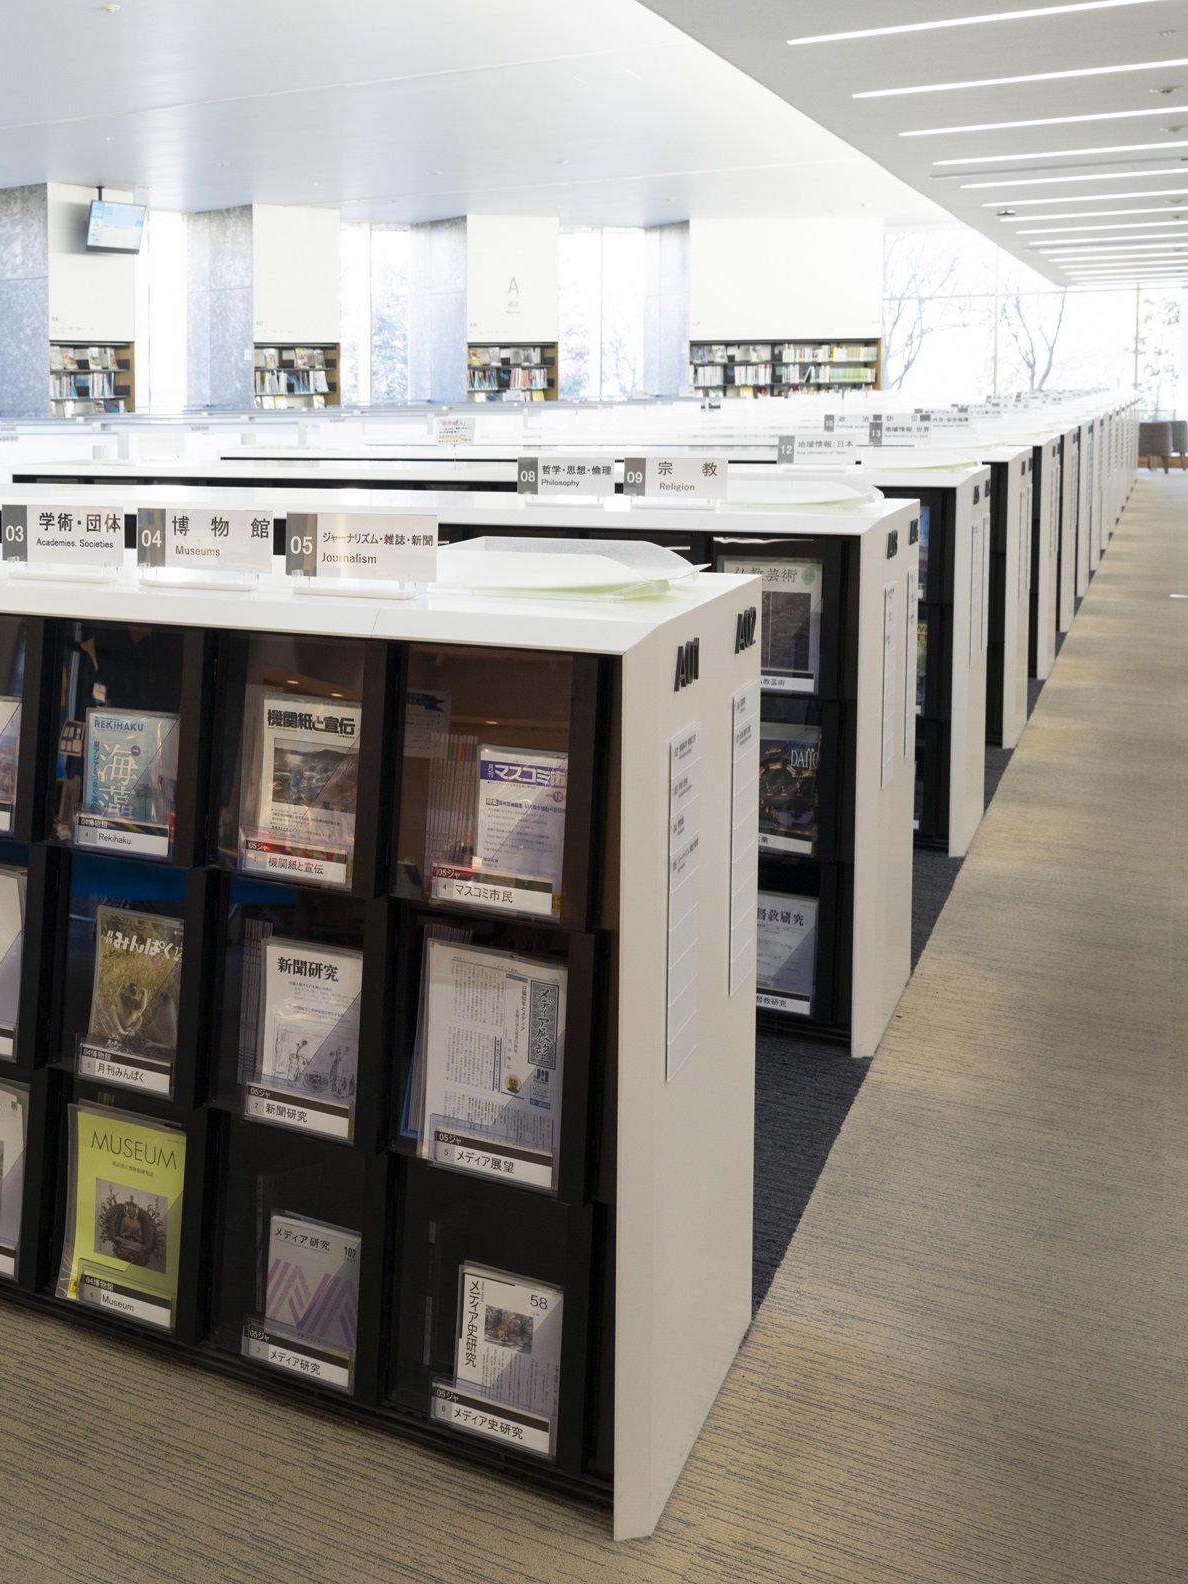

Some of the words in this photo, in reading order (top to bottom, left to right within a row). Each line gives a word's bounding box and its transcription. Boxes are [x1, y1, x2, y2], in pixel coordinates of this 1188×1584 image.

[508, 277, 519, 294] A
[780, 446, 792, 454] 12
[520, 471, 536, 482] 08
[542, 465, 611, 475] 哲学・思想・倫理
[658, 461, 672, 475] 宗
[702, 462, 717, 477] 教
[541, 479, 579, 487] Philosophy
[627, 472, 642, 483] 09
[660, 483, 695, 492] Religion
[39, 512, 121, 533] 学術・団体
[172, 516, 190, 536] 博
[211, 517, 229, 537] 物
[250, 518, 270, 539] 館
[6, 526, 24, 542] 03
[142, 530, 162, 548] 04
[322, 533, 433, 546] ジャーナリズム・雑誌・新聞
[79, 540, 113, 548] Societies
[175, 546, 221, 557] Museums
[290, 536, 313, 554] 05
[322, 553, 377, 564] Journalism
[735, 607, 756, 654] A02
[674, 637, 699, 692] A01
[761, 678, 785, 687] 教芸術
[267, 709, 355, 735] 機関紙と宣伝
[488, 763, 494, 777] 月刊
[81, 819, 107, 828] 04博物館
[98, 833, 131, 844] Rekihaku
[268, 857, 324, 874] 機関紙と宣伝
[438, 868, 460, 878] 05ジャ
[455, 884, 513, 903] マスコミ市民
[757, 907, 804, 926] 督教研究
[114, 931, 174, 959] みんぱく
[277, 956, 339, 982] 新聞研究
[756, 995, 787, 1008] 督教研究
[534, 988, 553, 1064] メディア展望
[84, 1048, 112, 1061] 04博物館
[97, 1063, 144, 1083] 月刊みんぱく
[251, 1088, 270, 1098] 05ジャ
[266, 1103, 307, 1123] 新聞研究
[439, 1133, 462, 1146] 05ジャ
[91, 1131, 177, 1170] MUSEUM
[456, 1150, 515, 1174] メディア展望
[344, 1247, 356, 1258] 107
[86, 1277, 114, 1292] 04博物館
[102, 1294, 134, 1312] Museum
[530, 1294, 548, 1310] 58
[465, 1280, 479, 1368] メディア史研究
[250, 1330, 269, 1343] 05ジャ
[270, 1350, 320, 1376] メディア研究
[437, 1390, 459, 1402] 05ジャ
[454, 1409, 523, 1440] メディア史研究
